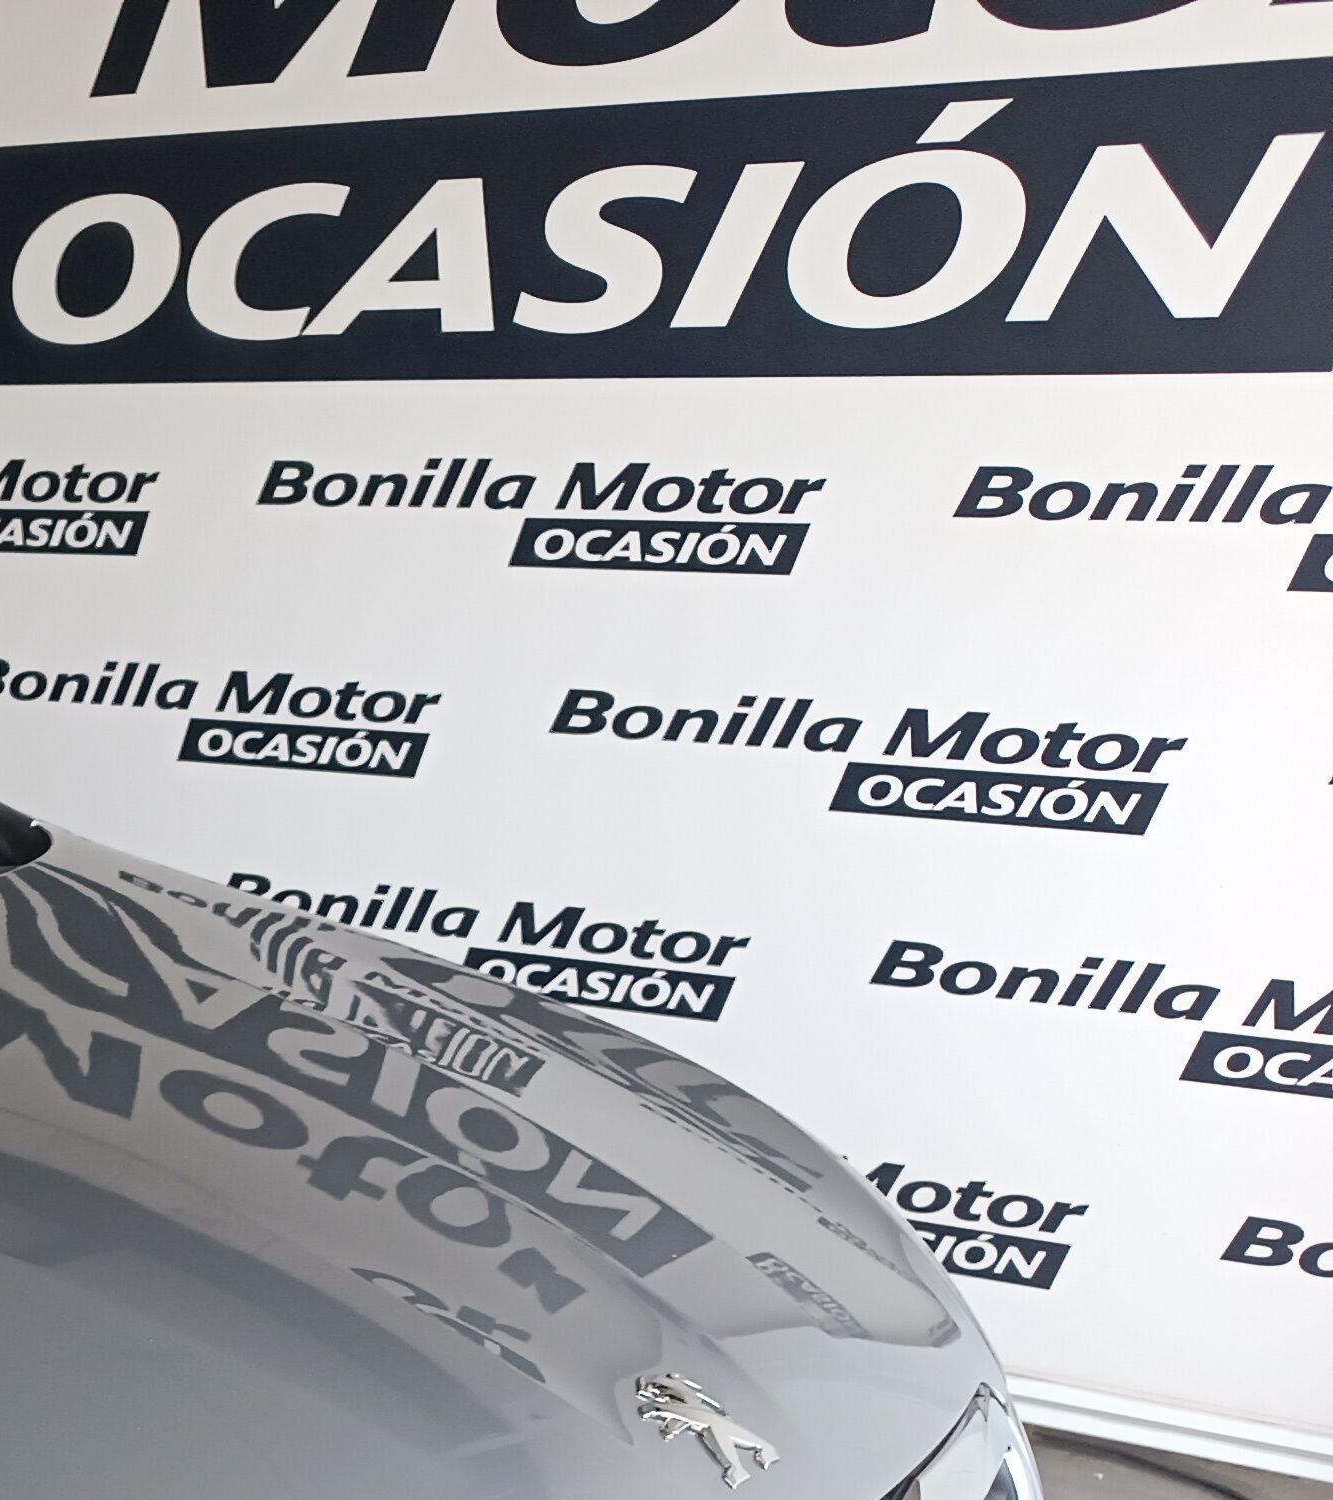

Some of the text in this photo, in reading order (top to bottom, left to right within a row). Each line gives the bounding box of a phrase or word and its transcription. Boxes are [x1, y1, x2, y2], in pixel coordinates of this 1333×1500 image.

[11, 99, 1326, 347] OCASIÓN
[257, 458, 827, 516] Bonilla Motor
[953, 464, 1333, 525] Bonilla
[533, 525, 787, 568] OCASIÓN
[214, 669, 442, 725] Motor
[197, 726, 411, 771] OCASIÓN
[548, 688, 1189, 774] Bonilla Motor
[856, 773, 1142, 826] OCASIÓN
[496, 900, 752, 967] Motor
[868, 938, 1222, 1022] Bonilla
